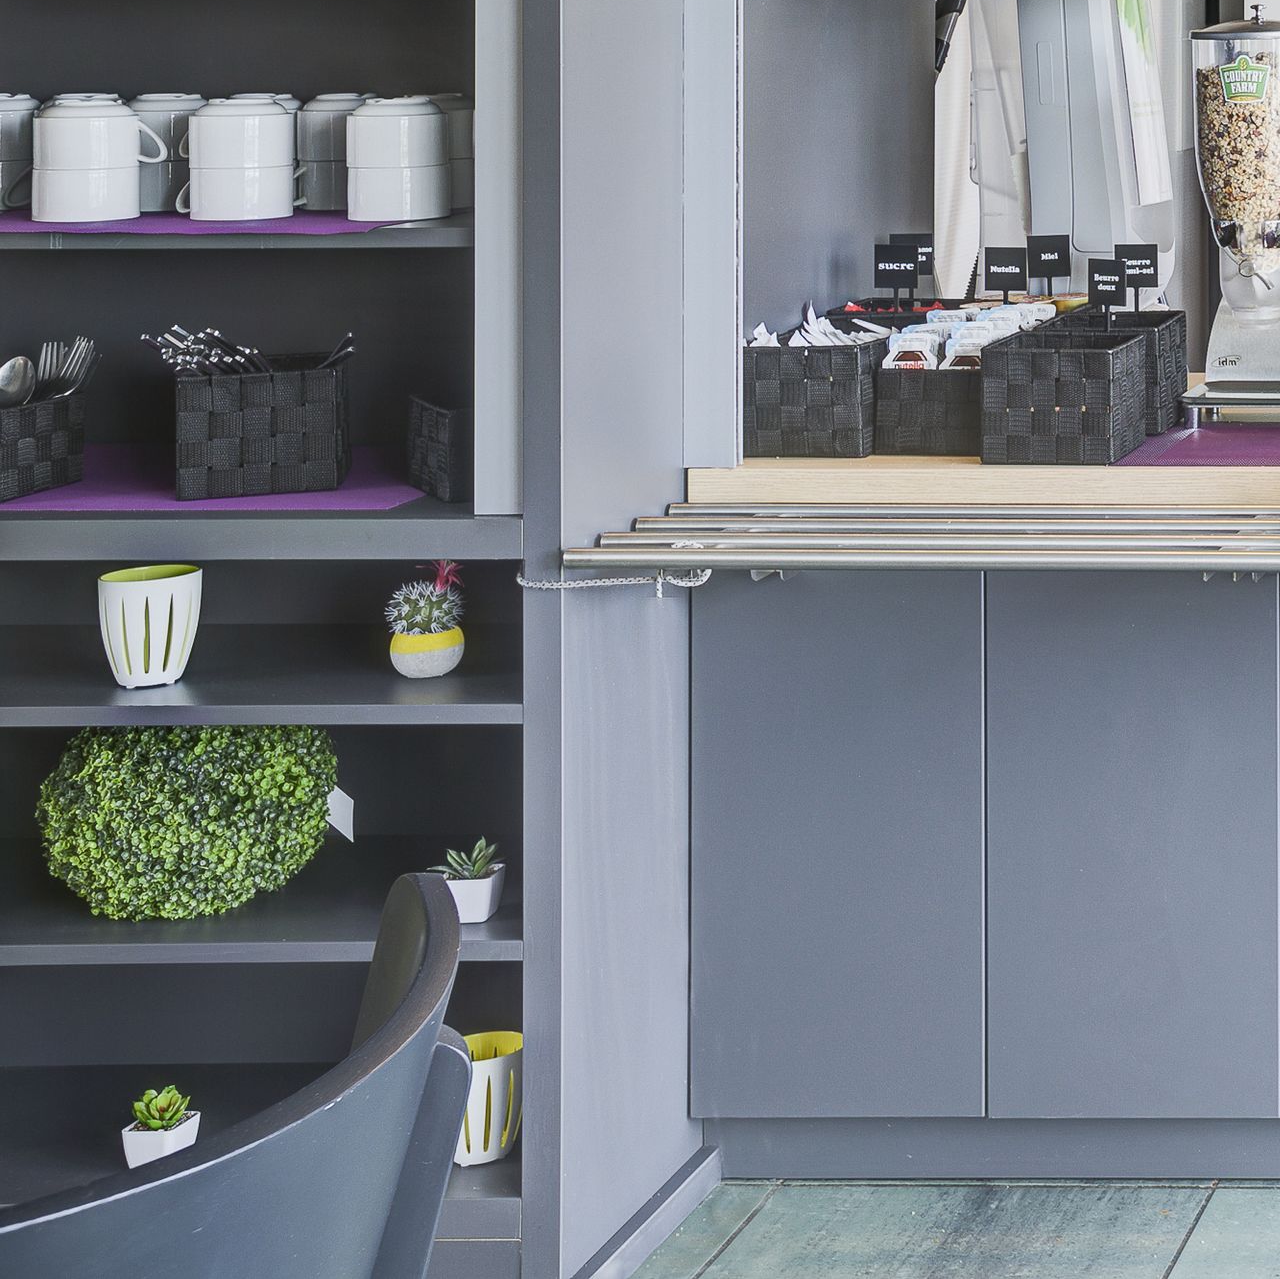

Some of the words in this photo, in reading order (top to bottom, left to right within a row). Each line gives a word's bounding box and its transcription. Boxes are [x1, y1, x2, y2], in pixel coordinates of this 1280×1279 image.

[1224, 70, 1265, 83] COUNTRY
[1231, 82, 1258, 94] FARM
[1041, 252, 1059, 261] Miel
[878, 261, 915, 271] sucre
[989, 264, 1021, 274] Nutella
[1093, 273, 1120, 283] Beurre
[1097, 283, 1117, 292] doux
[1218, 357, 1237, 367] idm
